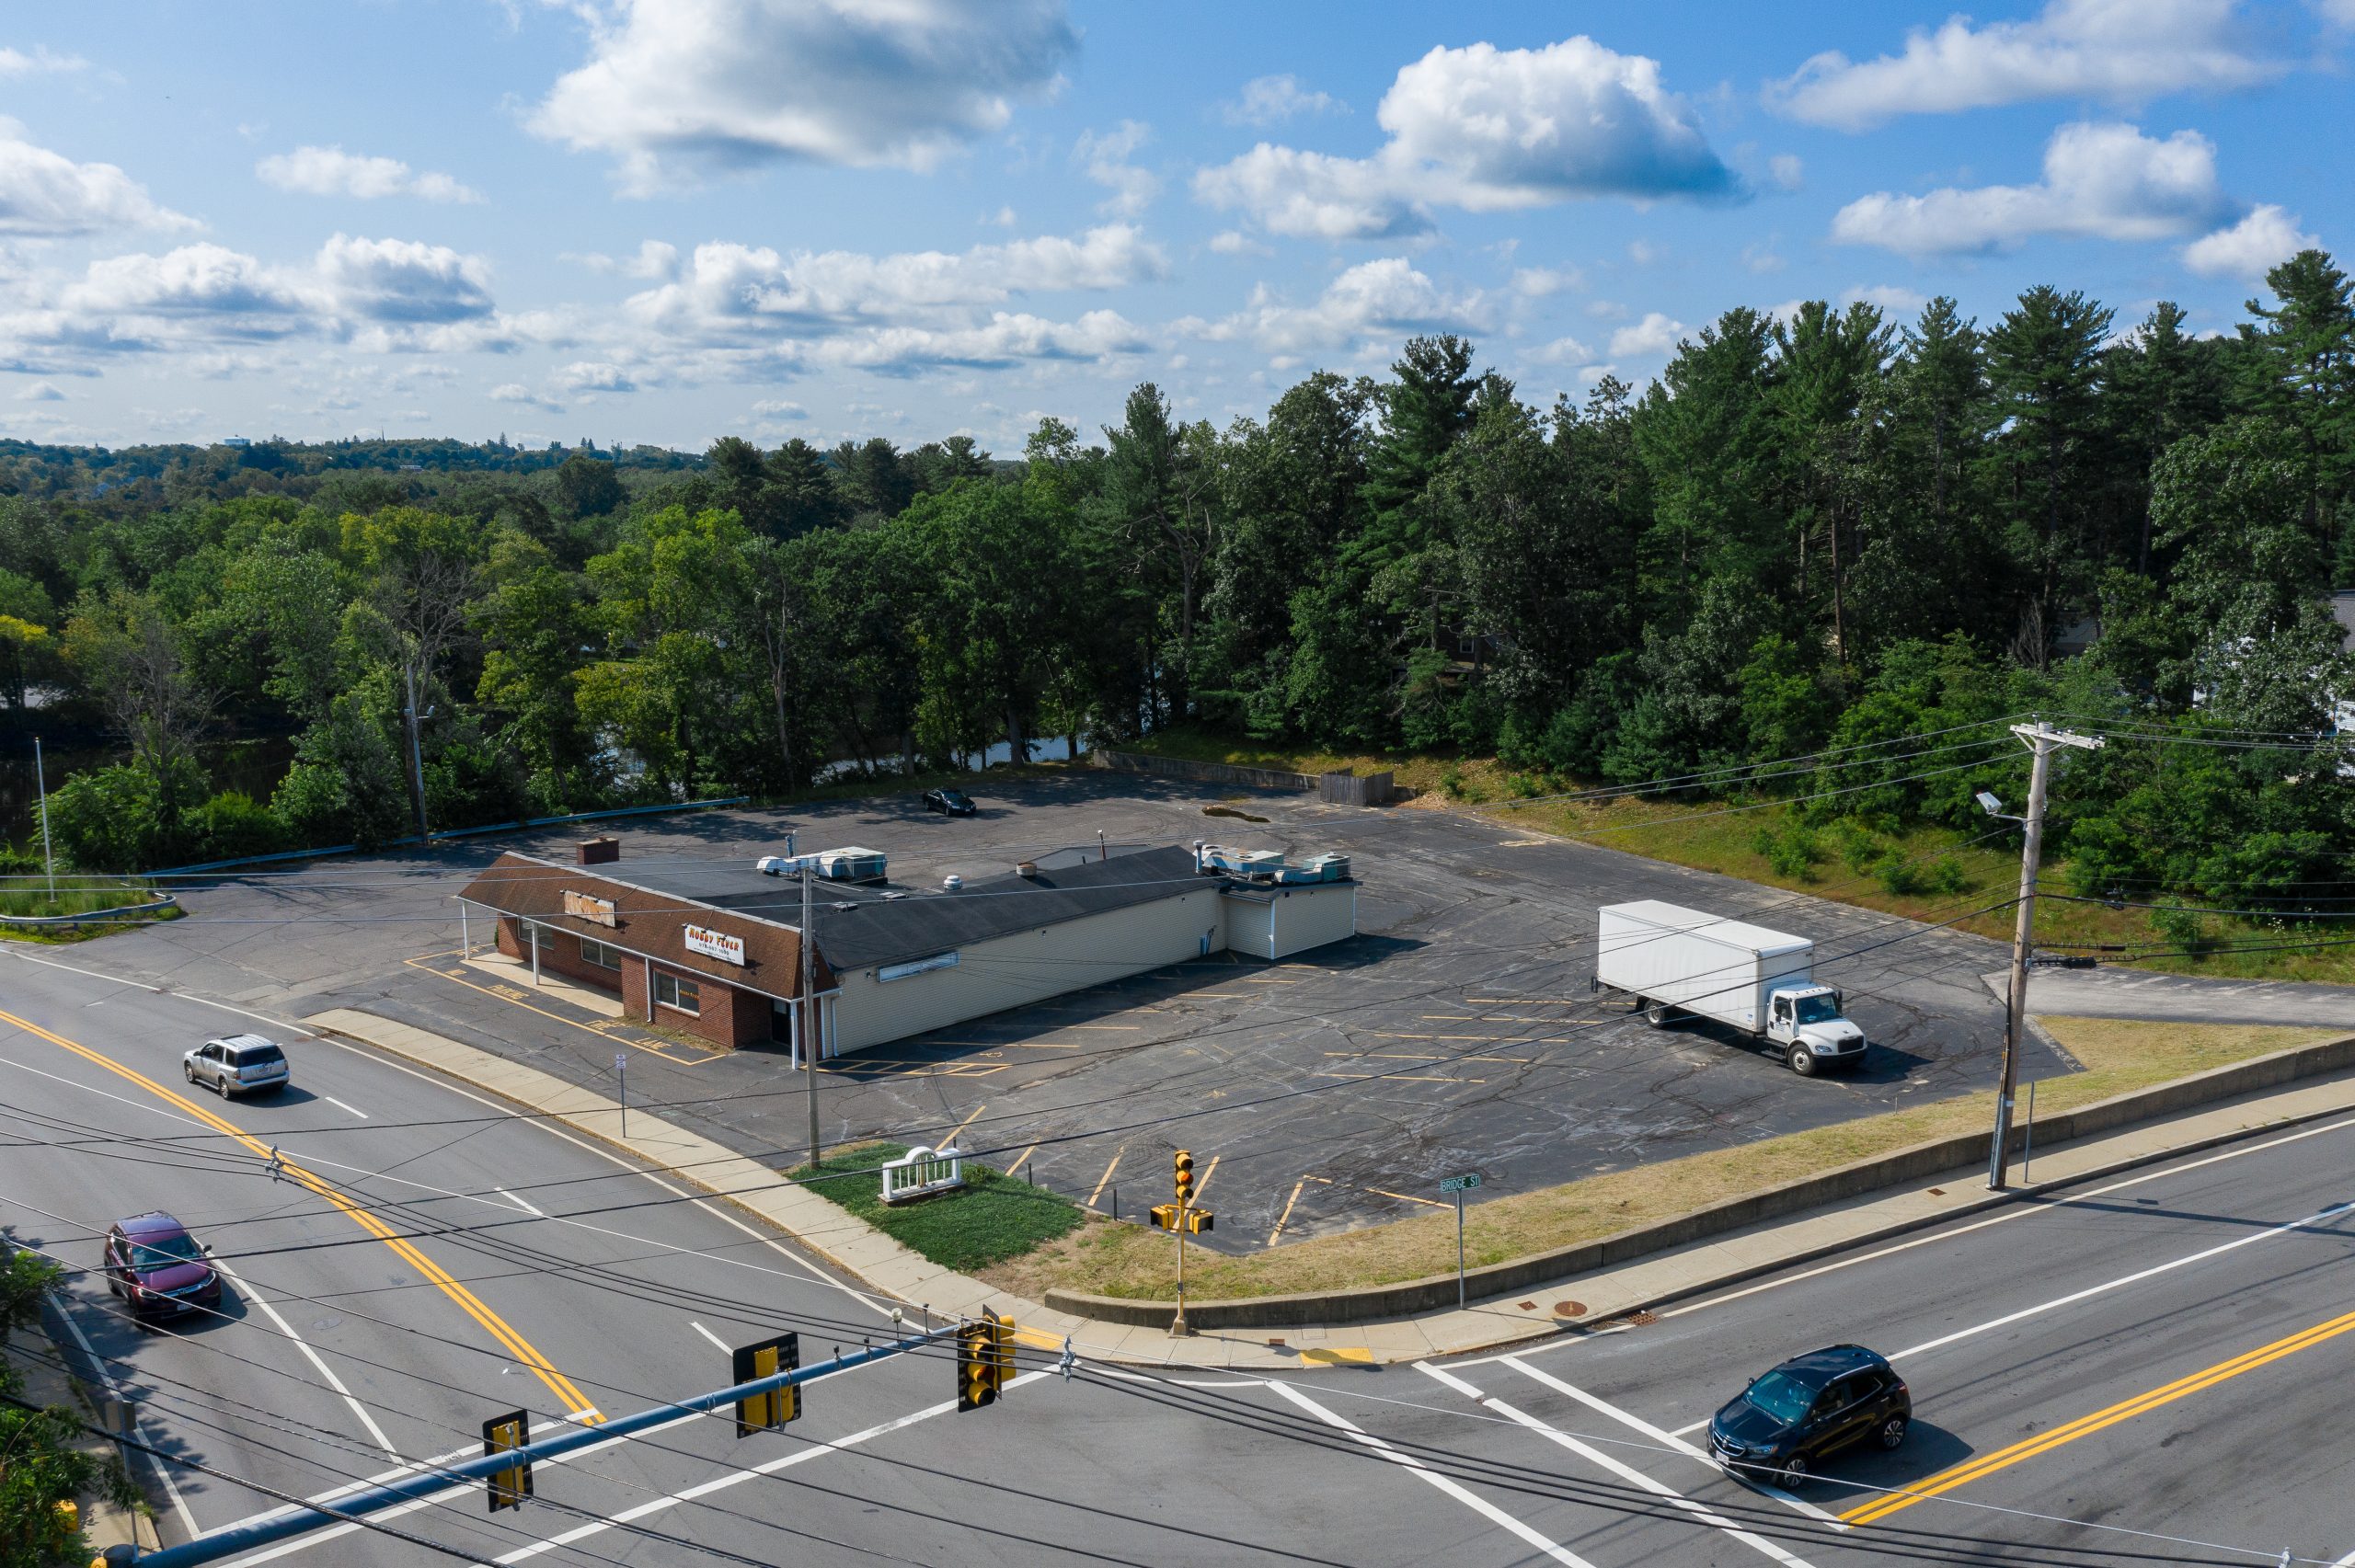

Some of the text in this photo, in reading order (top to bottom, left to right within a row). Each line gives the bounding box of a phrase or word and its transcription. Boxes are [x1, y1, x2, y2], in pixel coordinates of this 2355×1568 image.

[689, 927, 740, 952] HOBBY FEVER
[635, 1036, 672, 1050] LANE
[1442, 1175, 1479, 1192] BRIDGE ST
